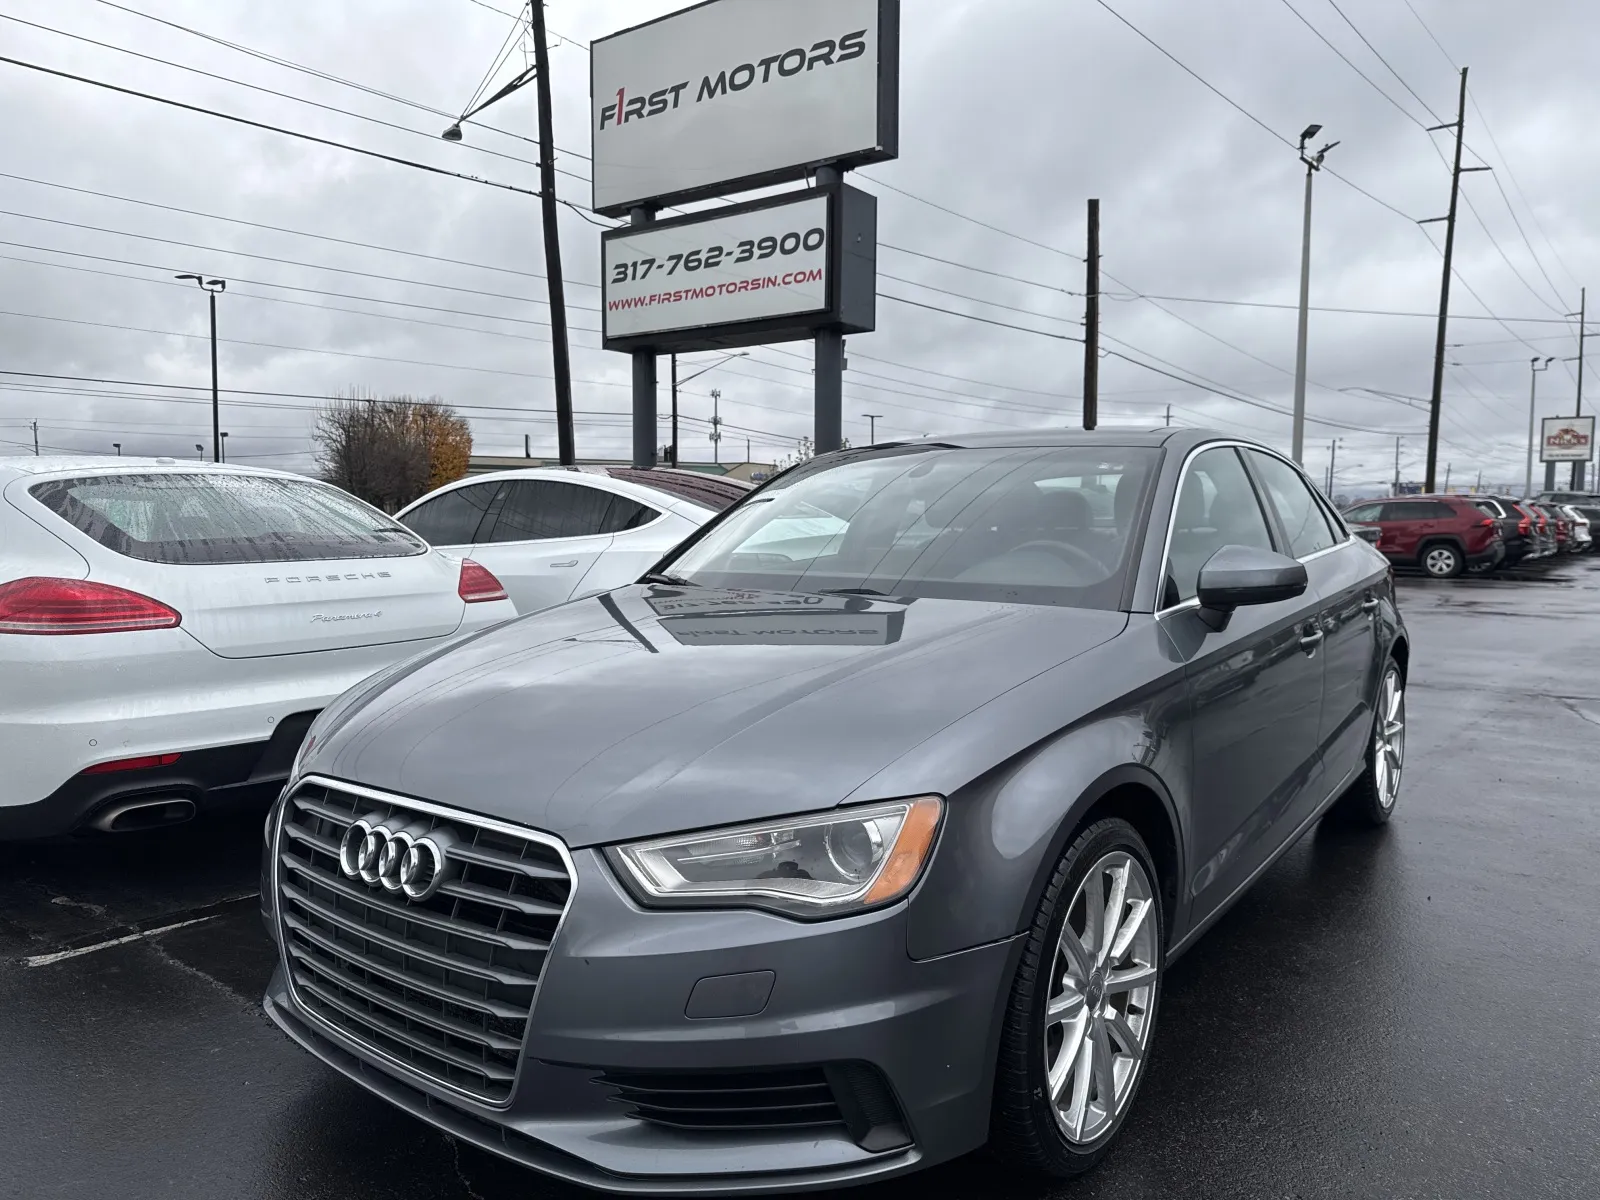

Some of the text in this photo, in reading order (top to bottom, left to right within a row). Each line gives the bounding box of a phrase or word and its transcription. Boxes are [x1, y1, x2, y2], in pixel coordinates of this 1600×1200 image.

[696, 29, 868, 103] MOTORS
[611, 227, 825, 285] 317-762-3900
[608, 268, 823, 312] WWW.FIRSTMOTORSIN.COM
[264, 571, 392, 584] PORSCHE
[310, 612, 372, 623] Panamera
